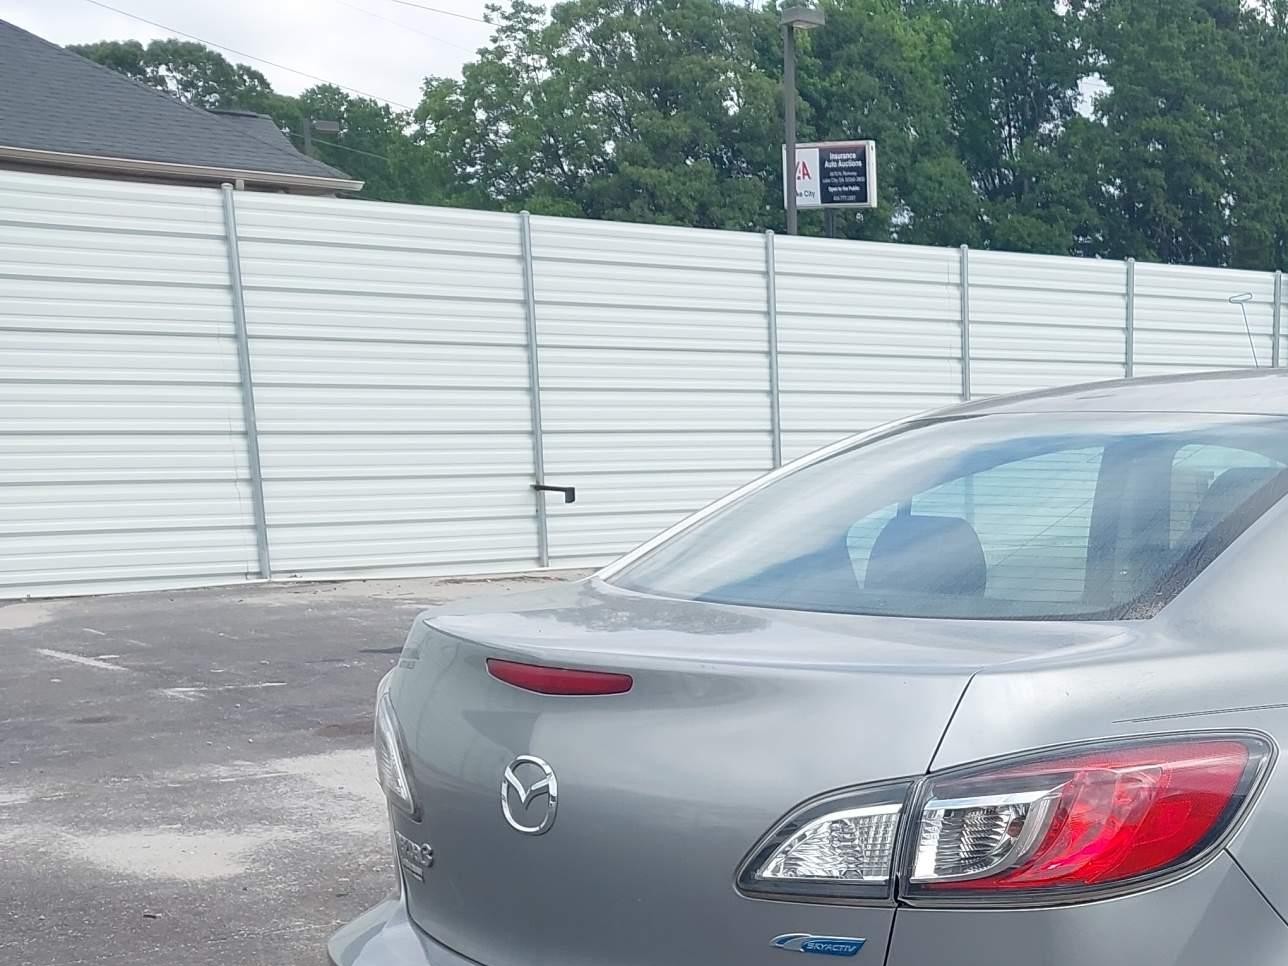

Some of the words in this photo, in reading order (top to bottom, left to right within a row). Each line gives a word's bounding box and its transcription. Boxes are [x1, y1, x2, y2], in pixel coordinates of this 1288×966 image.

[829, 152, 856, 160] Insurance
[824, 160, 837, 168] Auto
[838, 160, 862, 168] Auctions
[803, 190, 816, 199] City
[806, 942, 857, 952] SKYACTIV
